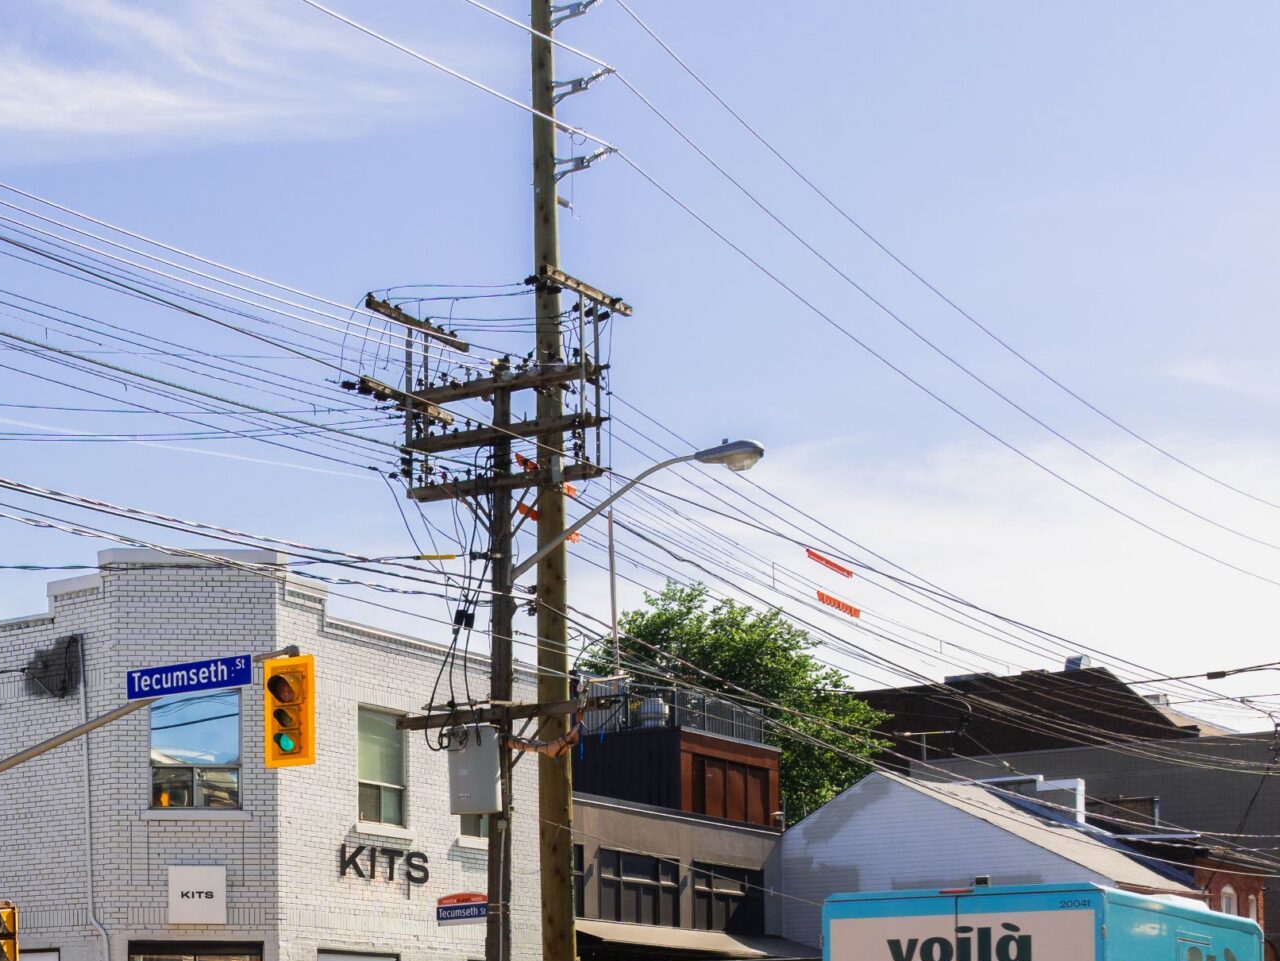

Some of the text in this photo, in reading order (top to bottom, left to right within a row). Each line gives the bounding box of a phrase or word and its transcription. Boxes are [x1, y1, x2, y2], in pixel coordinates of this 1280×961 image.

[132, 658, 246, 692] Tecumseth St
[339, 843, 429, 885] KITS
[181, 891, 214, 899] KITS
[1060, 900, 1091, 909] 20041
[438, 906, 478, 919] Tecumseth
